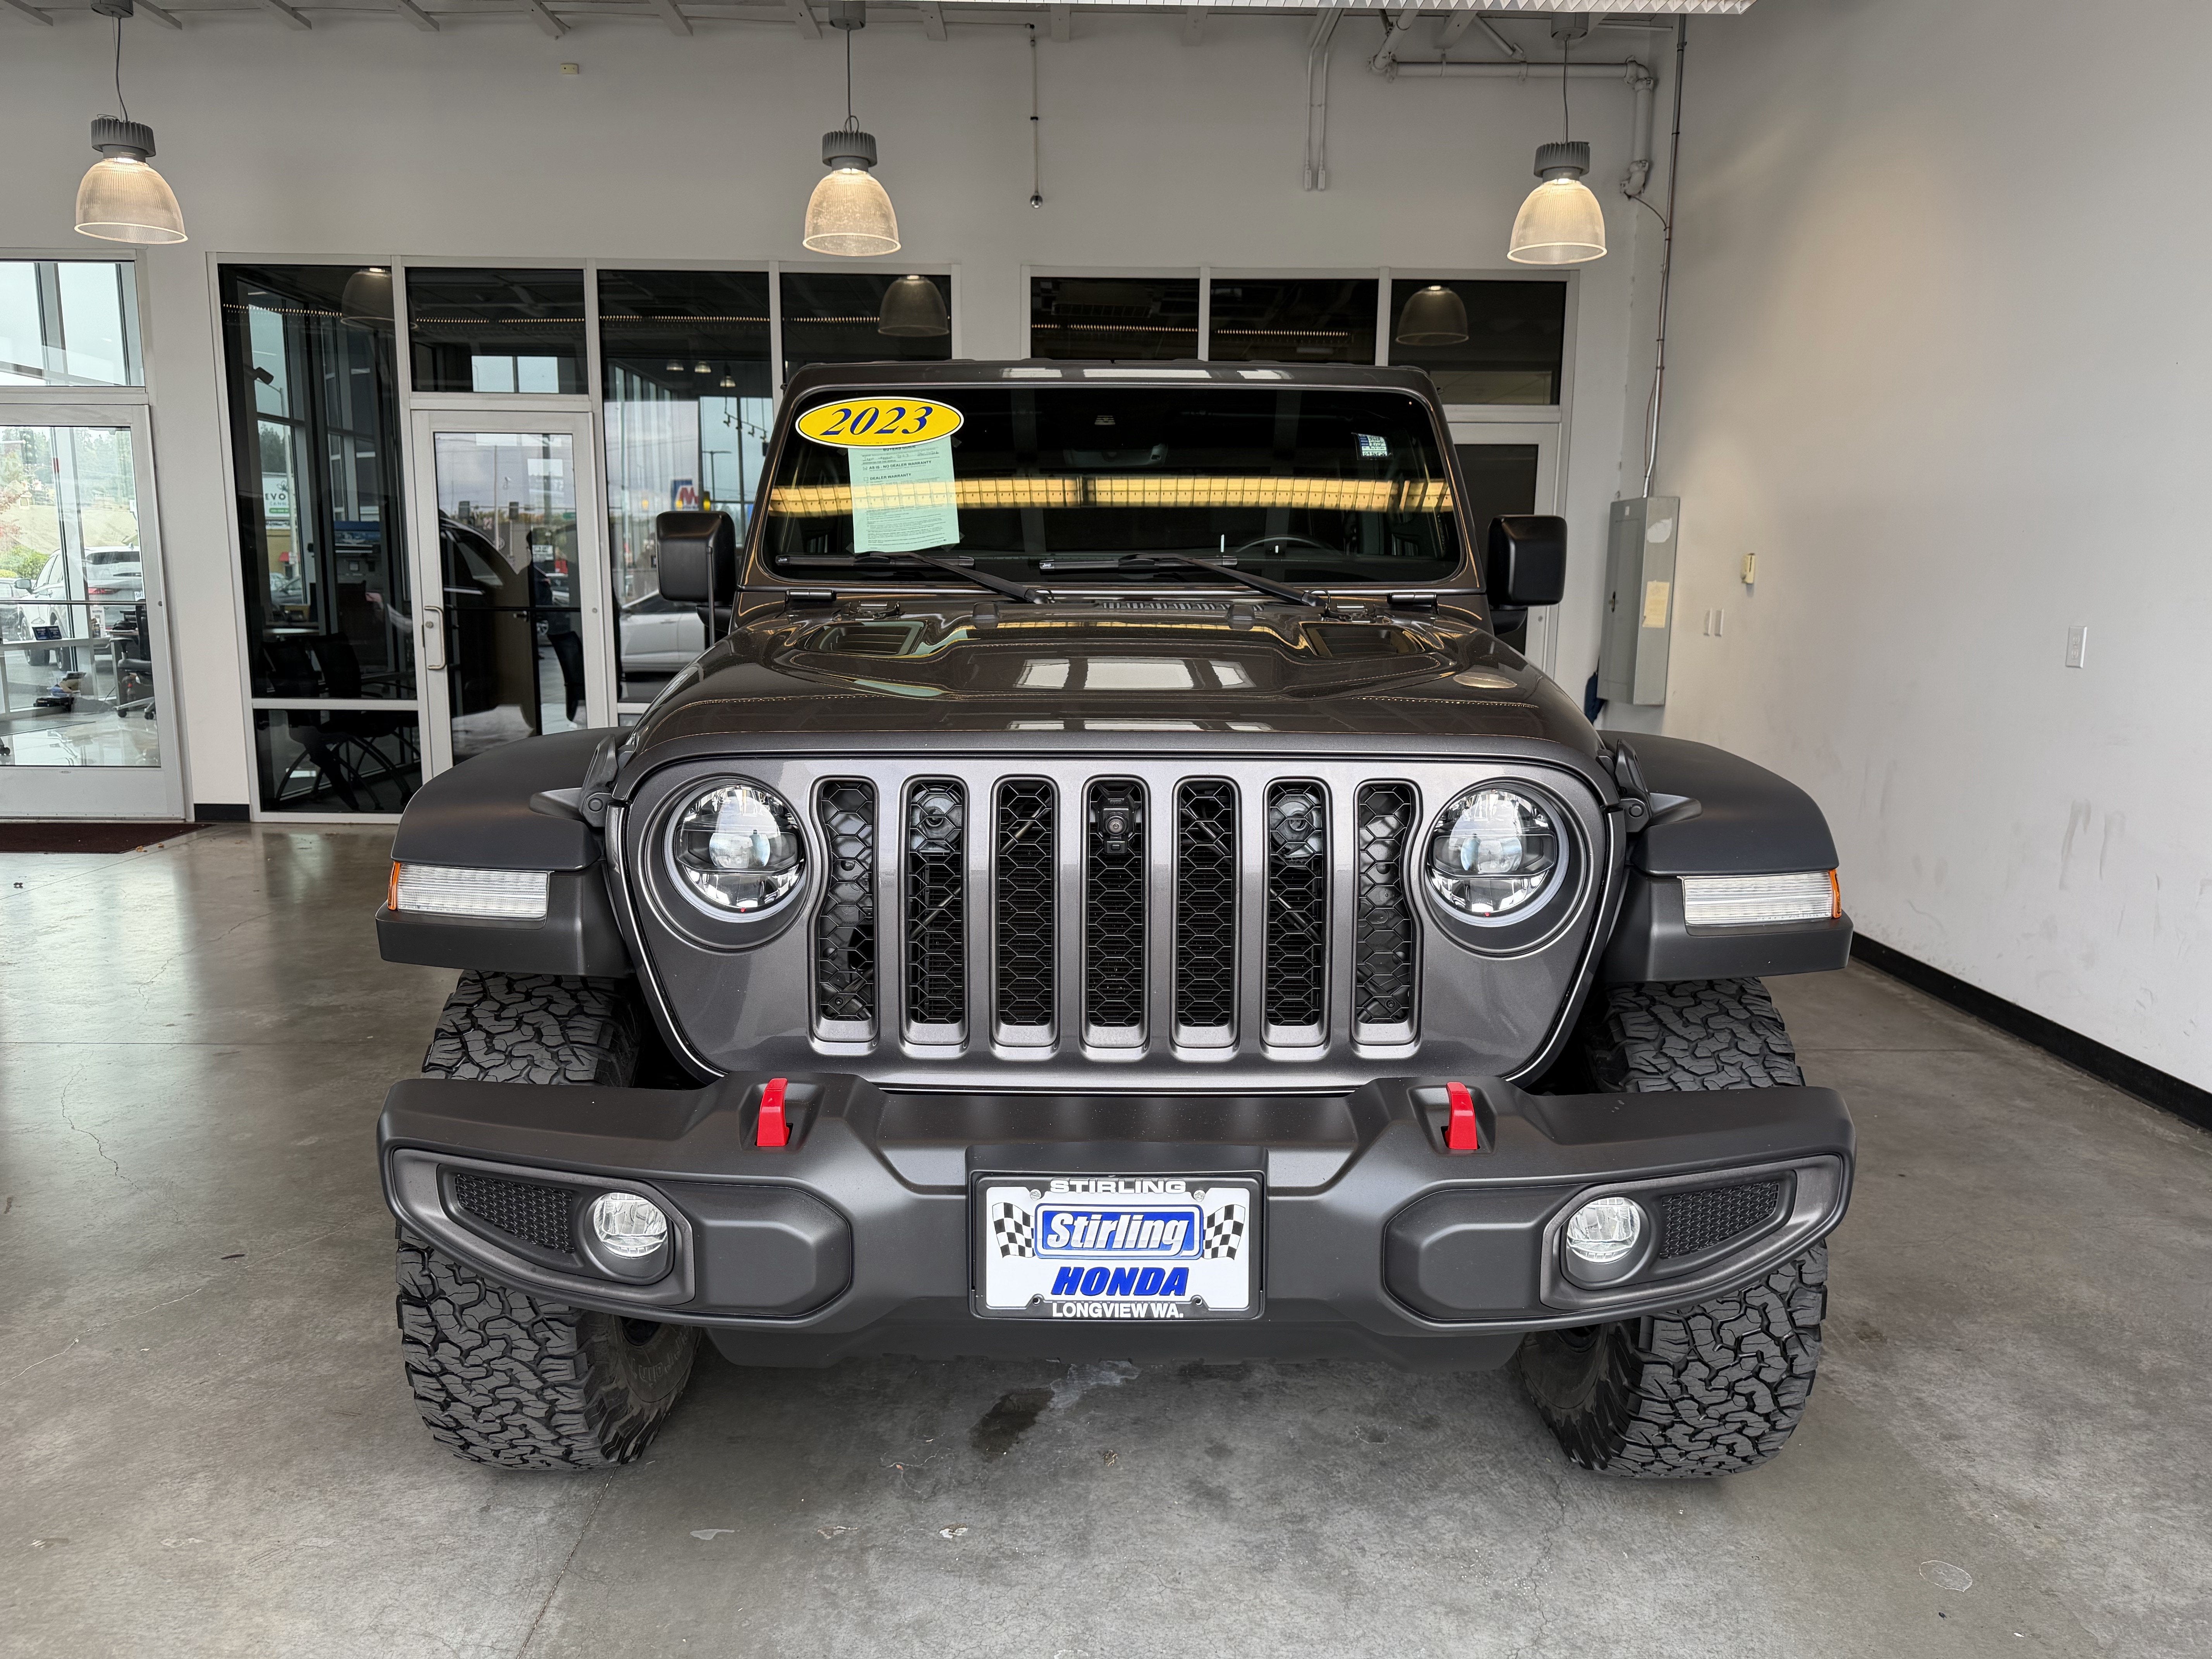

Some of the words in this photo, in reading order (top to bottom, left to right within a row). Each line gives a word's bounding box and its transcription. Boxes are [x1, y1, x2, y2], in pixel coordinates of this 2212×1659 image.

[819, 406, 933, 435] 2023
[1050, 1179, 1186, 1194] STIRLING
[1047, 1212, 1190, 1257] Stirling
[1050, 1266, 1190, 1296] HONDA
[1052, 1302, 1148, 1318] LONGVIEW
[1149, 1302, 1183, 1318] WA.
